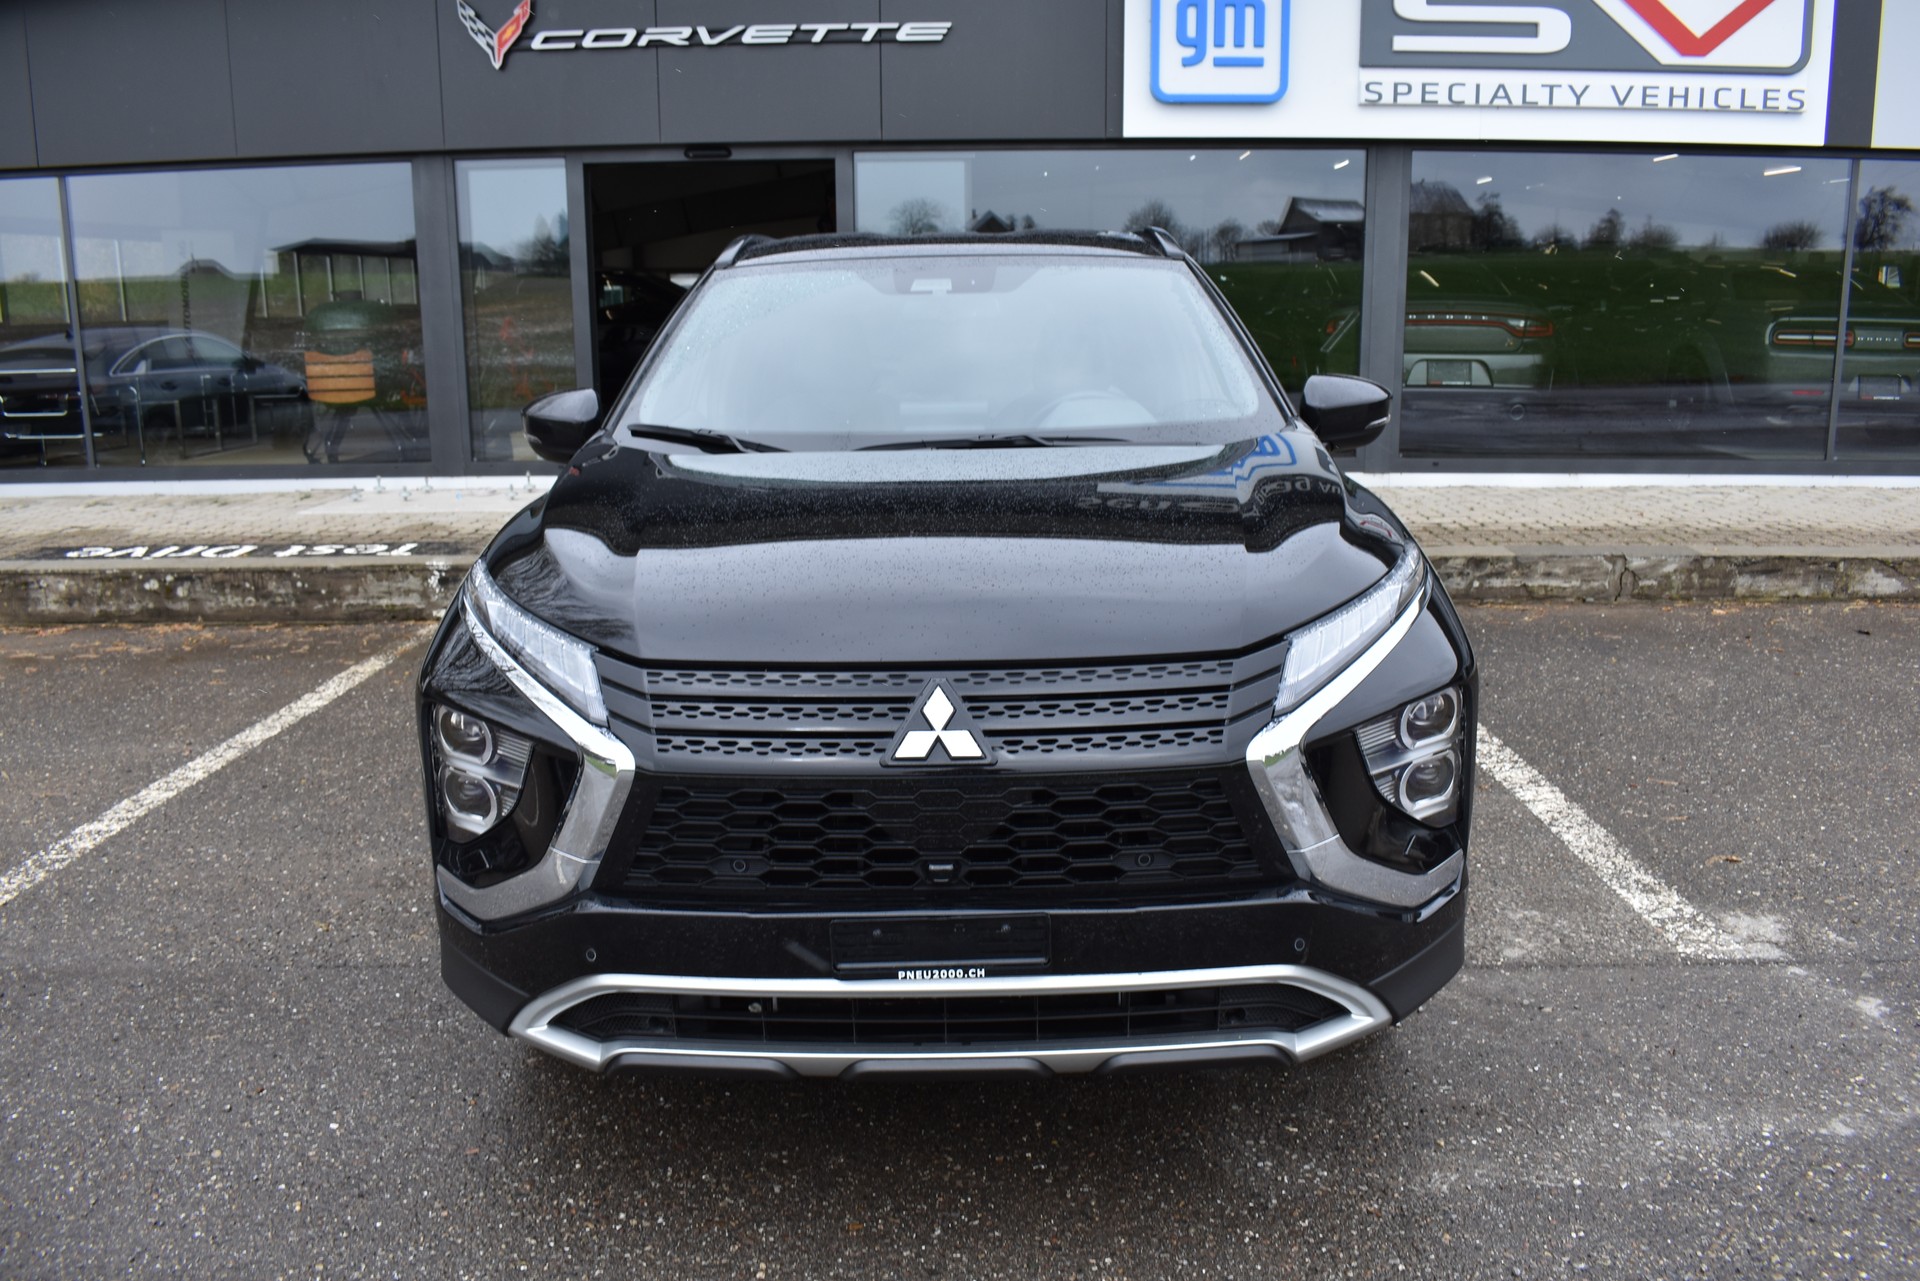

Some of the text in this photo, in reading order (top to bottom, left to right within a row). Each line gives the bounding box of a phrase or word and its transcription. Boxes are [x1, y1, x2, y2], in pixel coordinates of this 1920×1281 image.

[531, 21, 952, 51] CORVETTE
[1176, 0, 1265, 67] gm
[1364, 81, 1806, 110] SPECIALTY VEHICLES
[897, 968, 986, 981] PNEU2000.CH
